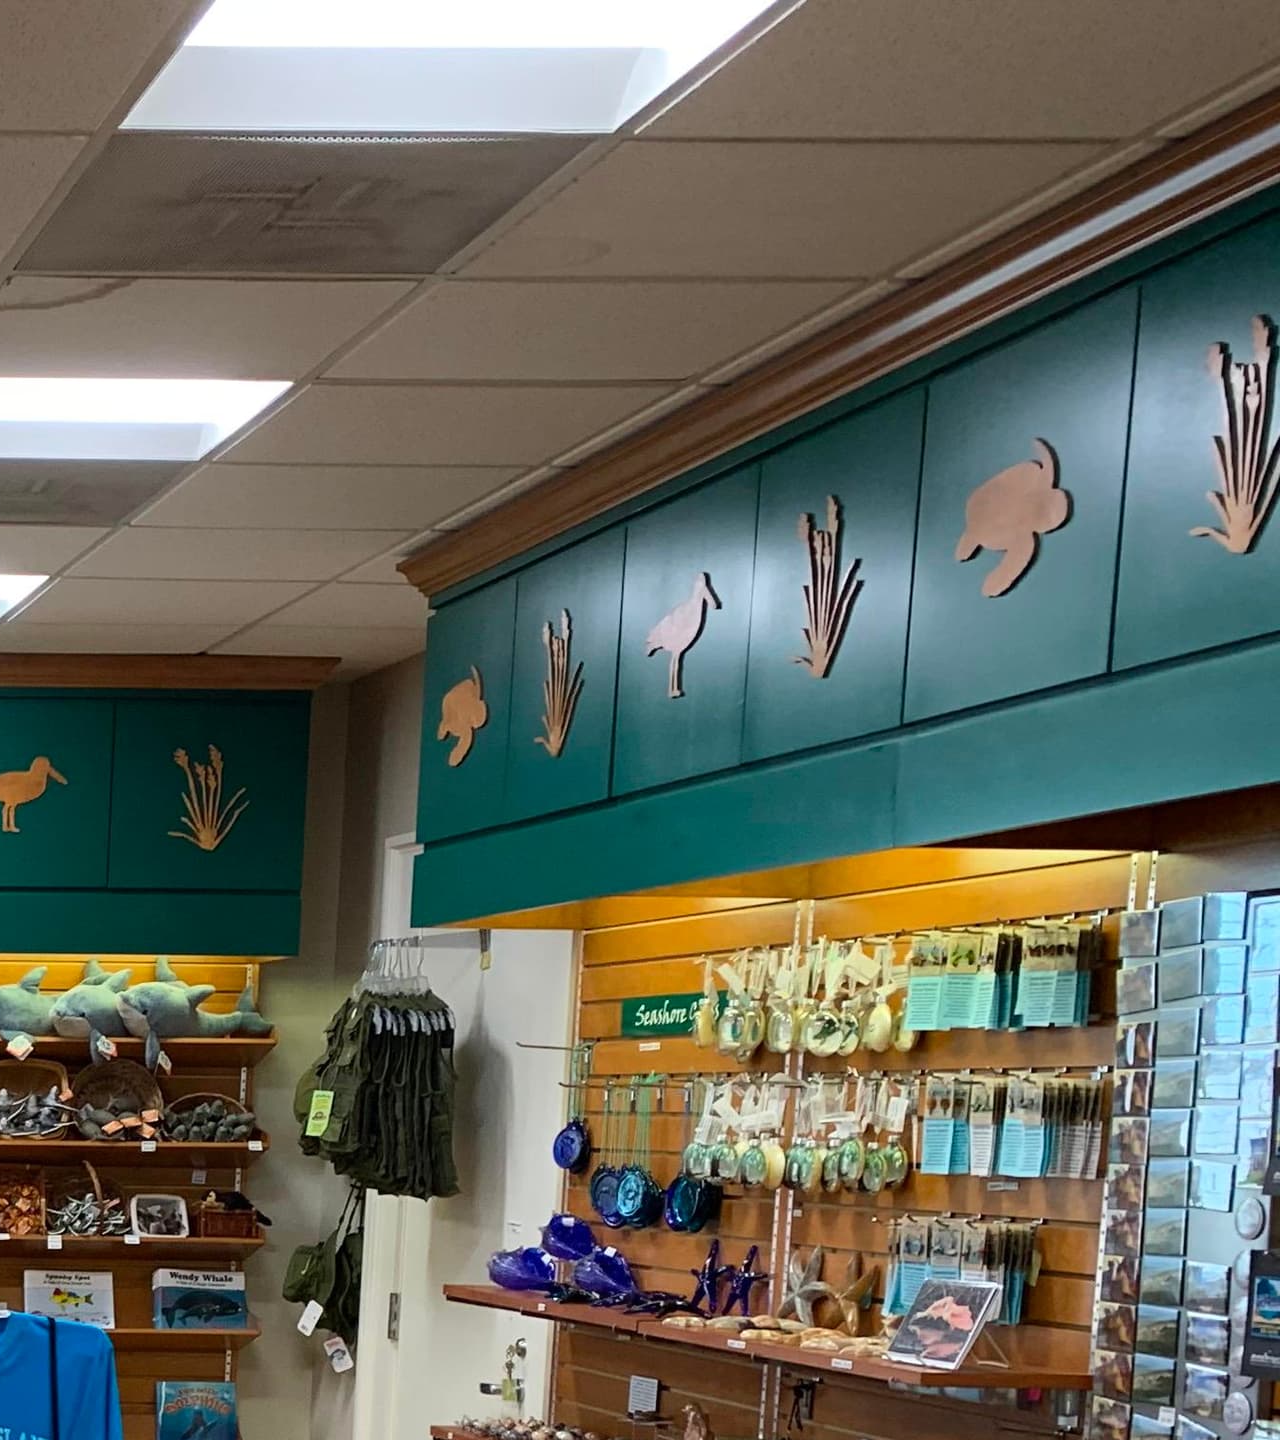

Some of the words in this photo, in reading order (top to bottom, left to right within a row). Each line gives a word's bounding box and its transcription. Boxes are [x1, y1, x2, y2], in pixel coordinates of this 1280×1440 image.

[635, 1000, 687, 1026] Seashore
[169, 1271, 200, 1282] Wendy
[202, 1273, 233, 1283] Whale
